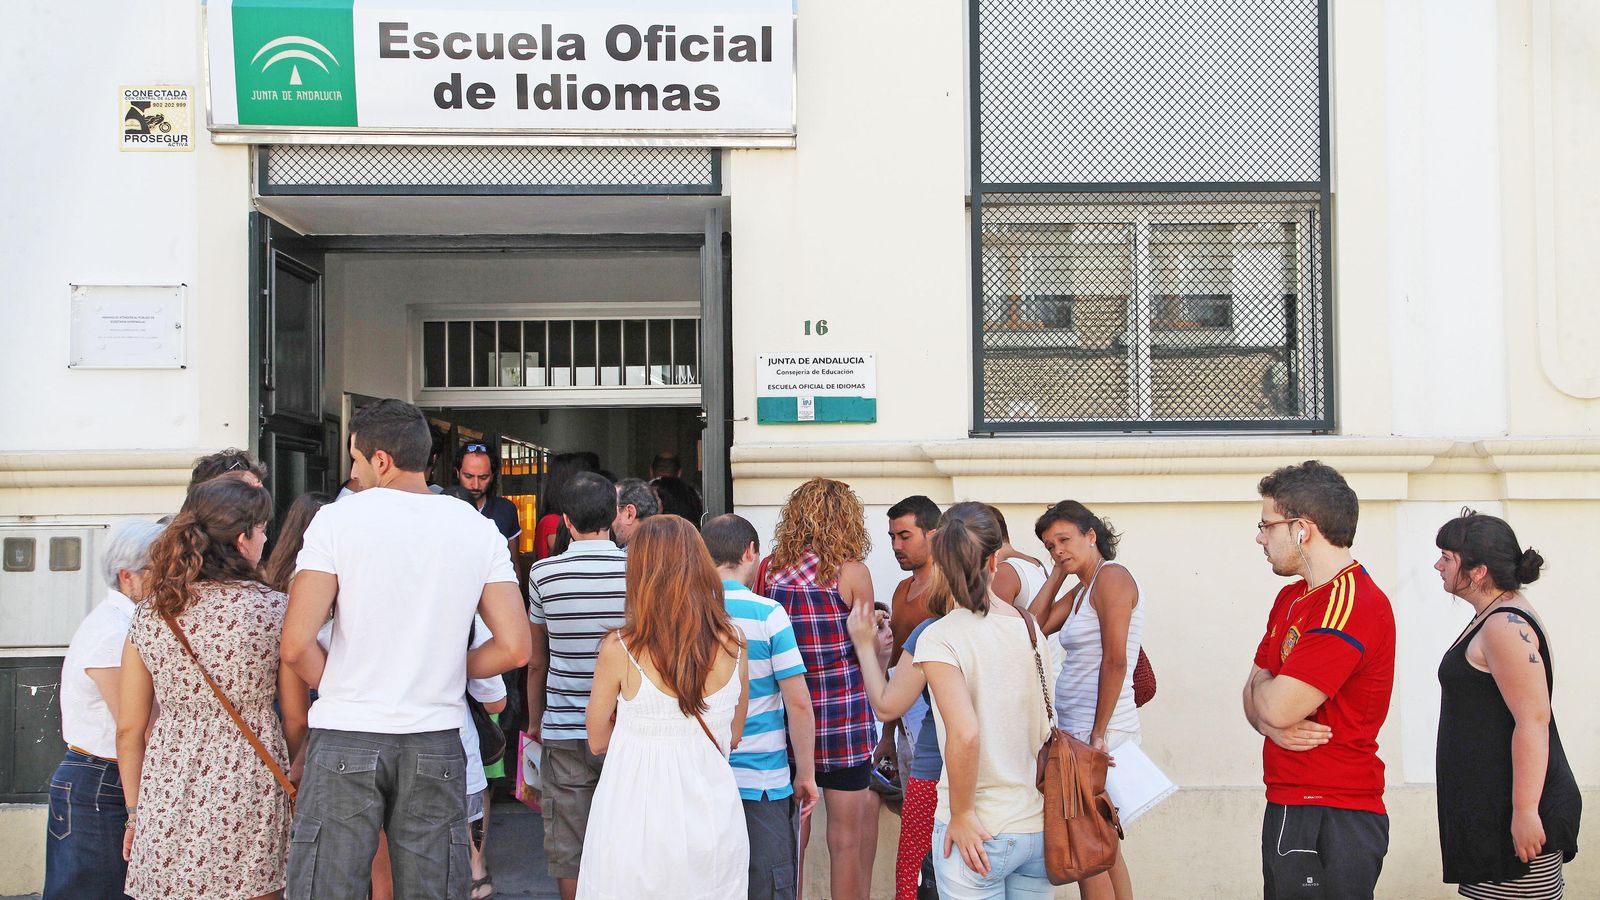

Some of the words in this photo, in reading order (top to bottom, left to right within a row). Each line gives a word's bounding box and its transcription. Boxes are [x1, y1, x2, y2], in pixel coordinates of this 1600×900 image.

[378, 21, 587, 62] Escuela
[605, 23, 773, 63] Oficial
[251, 90, 278, 101] JUNTA
[282, 90, 292, 101] DE
[433, 72, 497, 110] de
[516, 73, 722, 111] Idiomas
[124, 134, 188, 142] PROSEGUR
[804, 319, 829, 336] 16
[768, 357, 797, 366] JUNTA
[798, 357, 810, 365] DE
